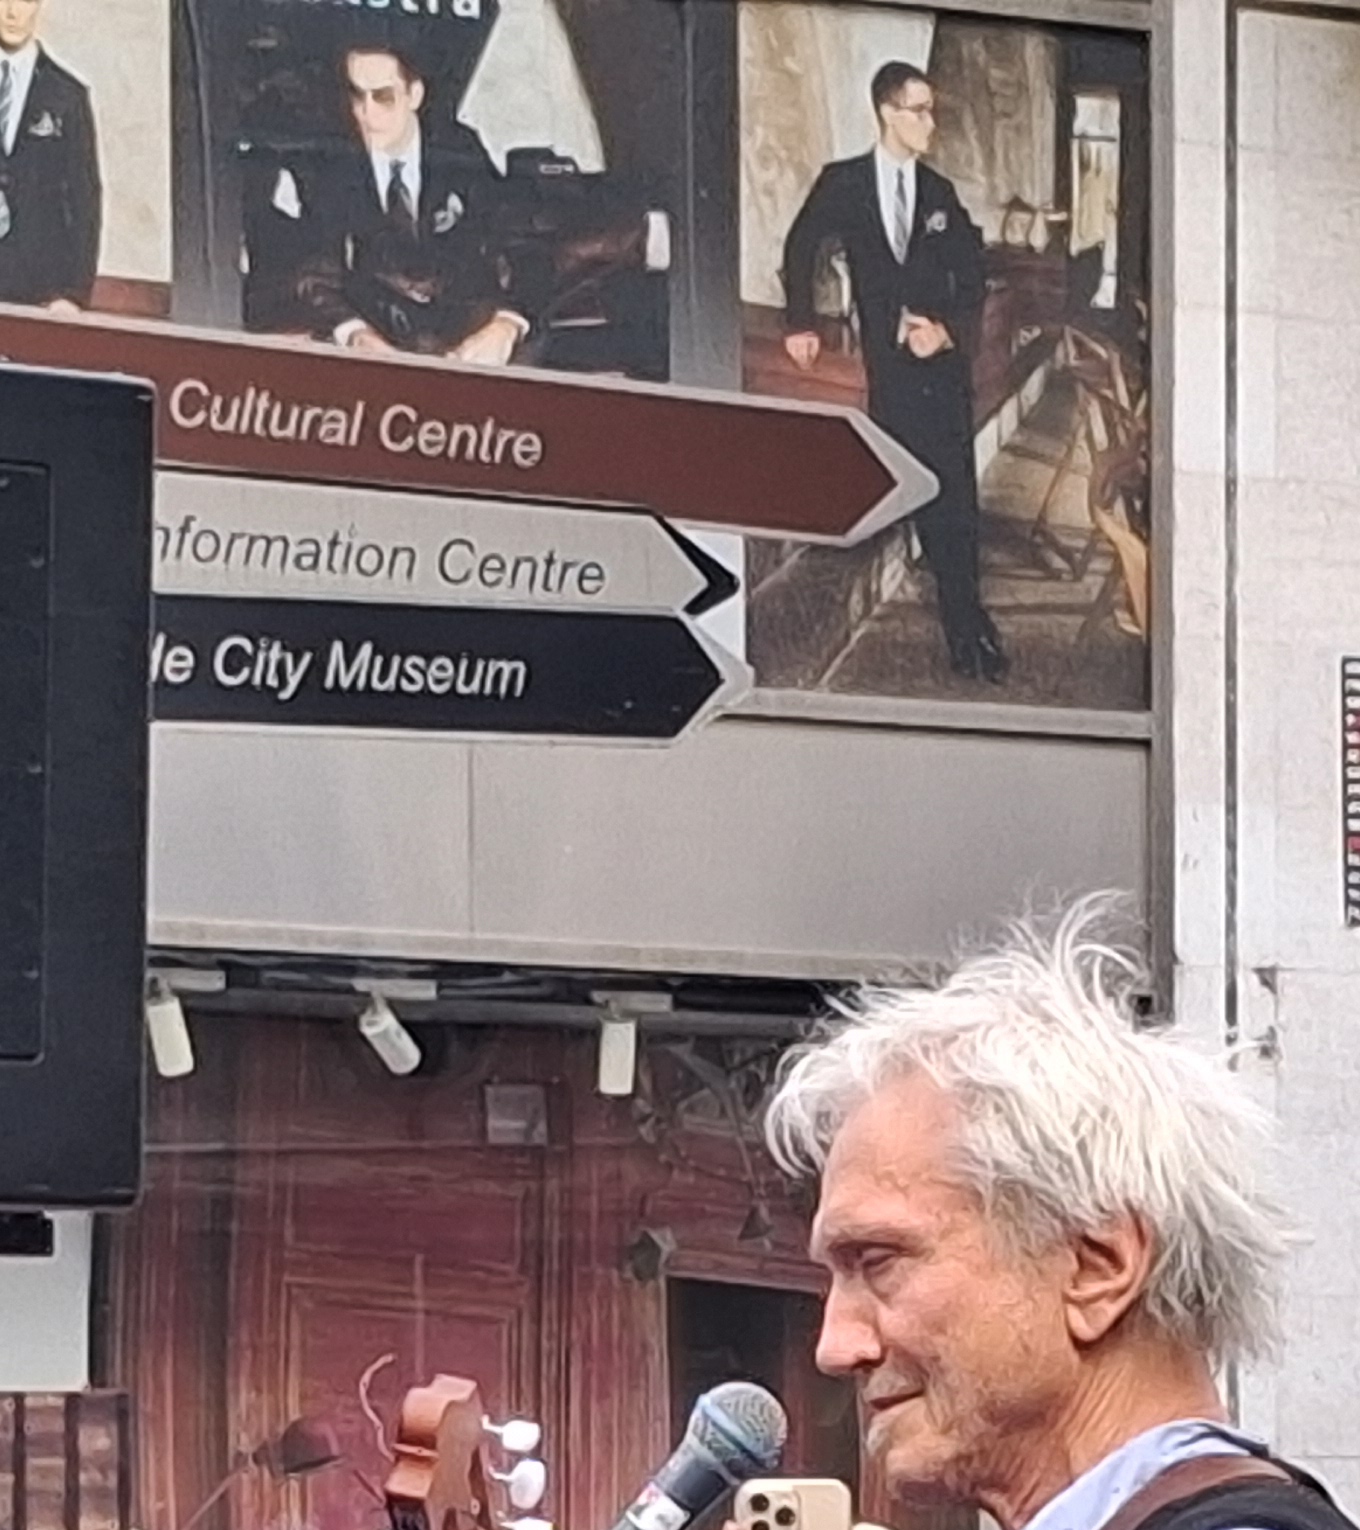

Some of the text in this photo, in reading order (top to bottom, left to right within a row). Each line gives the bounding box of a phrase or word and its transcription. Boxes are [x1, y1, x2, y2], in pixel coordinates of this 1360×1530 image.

[169, 378, 544, 469] Cultural Centre
[438, 538, 607, 596] Centre
[213, 635, 313, 700] City
[324, 640, 528, 699] Museum
